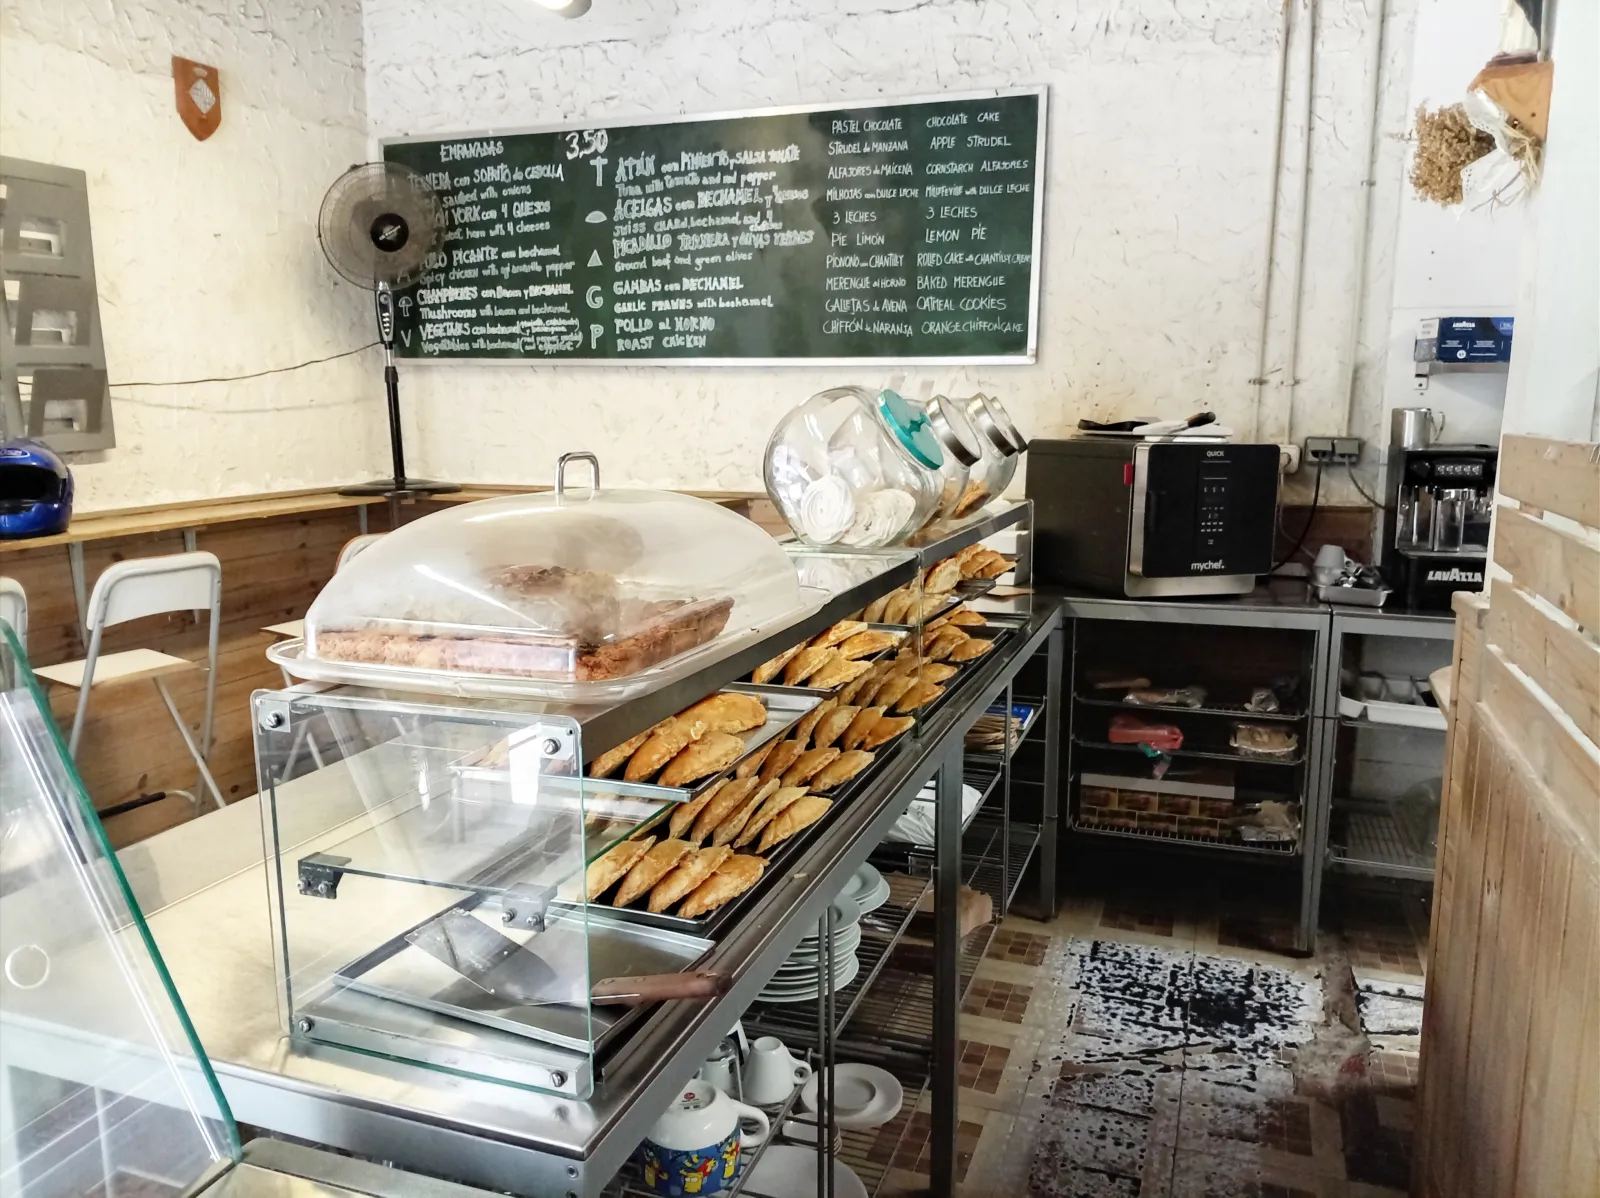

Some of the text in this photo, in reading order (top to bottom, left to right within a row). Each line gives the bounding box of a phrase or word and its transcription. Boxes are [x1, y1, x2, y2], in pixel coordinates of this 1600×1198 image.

[832, 118, 903, 134] PASTEL CHOCOLATE
[926, 111, 1000, 128] CHOCOLATE CAKE
[565, 129, 608, 160] 3,50
[828, 141, 861, 156] STRUDEL
[871, 140, 908, 153] MANZANA
[930, 135, 1012, 150] APPLE STRUDEL
[440, 140, 504, 162] EMPANADAS
[661, 161, 679, 173] con
[828, 166, 872, 180] ALFAJORES
[926, 160, 1029, 175] CORNSTARCH ALFAJORES
[454, 176, 470, 187] con
[702, 171, 721, 185] and
[502, 184, 532, 196] onions
[826, 187, 862, 201] MILHOJAS
[876, 189, 897, 199] DULCE
[979, 184, 1003, 195] DULCE
[451, 205, 481, 225] YORK
[481, 209, 497, 220] con
[501, 203, 508, 218] 4
[613, 196, 673, 222] ACELGAS
[675, 200, 695, 211] con
[833, 210, 877, 224] 3 LECHES
[926, 206, 978, 219] 3 LECHES
[831, 232, 848, 247] PIE
[926, 222, 987, 243] LEMON PIE
[452, 245, 499, 266] PICANTE
[674, 253, 692, 265] and
[695, 255, 721, 271] green
[725, 249, 754, 262] olives
[826, 253, 860, 269] PIONONO
[917, 253, 942, 267] ROLLED
[944, 252, 964, 264] CAKE
[613, 278, 661, 296] GAMBAS
[664, 282, 681, 292] con
[826, 276, 870, 291] MERENGUE
[881, 277, 907, 289] HORNO
[917, 275, 1006, 290] BAKED MERENGUE
[585, 285, 604, 309] G
[916, 296, 1007, 311] OATMEAL COOKIES
[825, 298, 870, 315] GALLETAS
[881, 298, 908, 313] AVENA
[614, 316, 715, 334] POLLO al HORNO
[873, 320, 913, 338] NARANJA
[921, 320, 962, 334] ORANGE
[962, 317, 1000, 332] CHIFFON
[400, 329, 412, 348] V
[590, 324, 604, 349] P
[617, 336, 654, 351] ROAST
[1427, 568, 1483, 582] LAVAZZA
